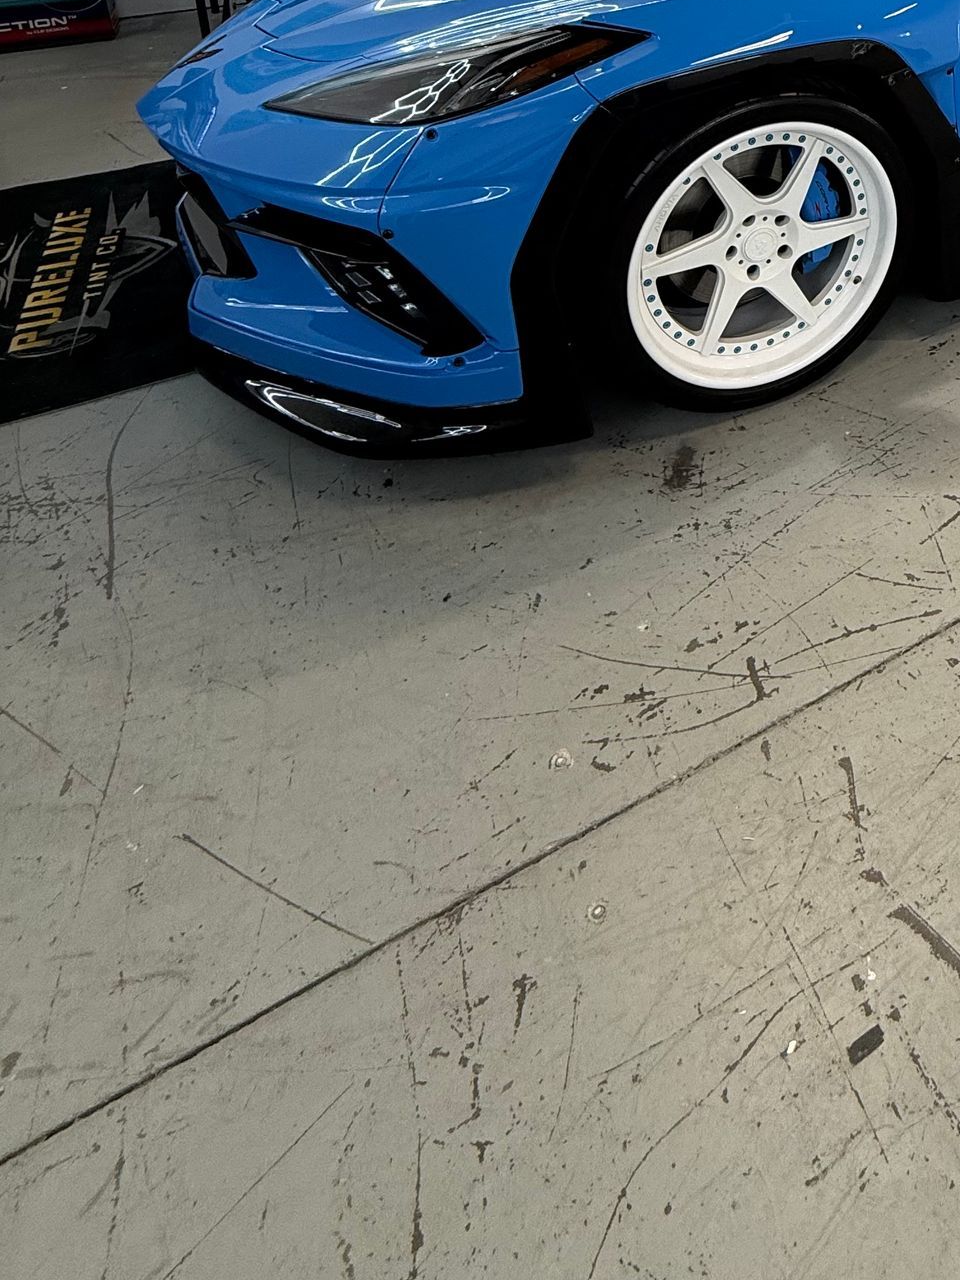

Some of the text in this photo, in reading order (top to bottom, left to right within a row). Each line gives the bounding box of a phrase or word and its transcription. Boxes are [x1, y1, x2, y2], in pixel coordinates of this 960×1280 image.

[8, 207, 92, 354] PURELUXE
[83, 229, 121, 300] TINT CO.
